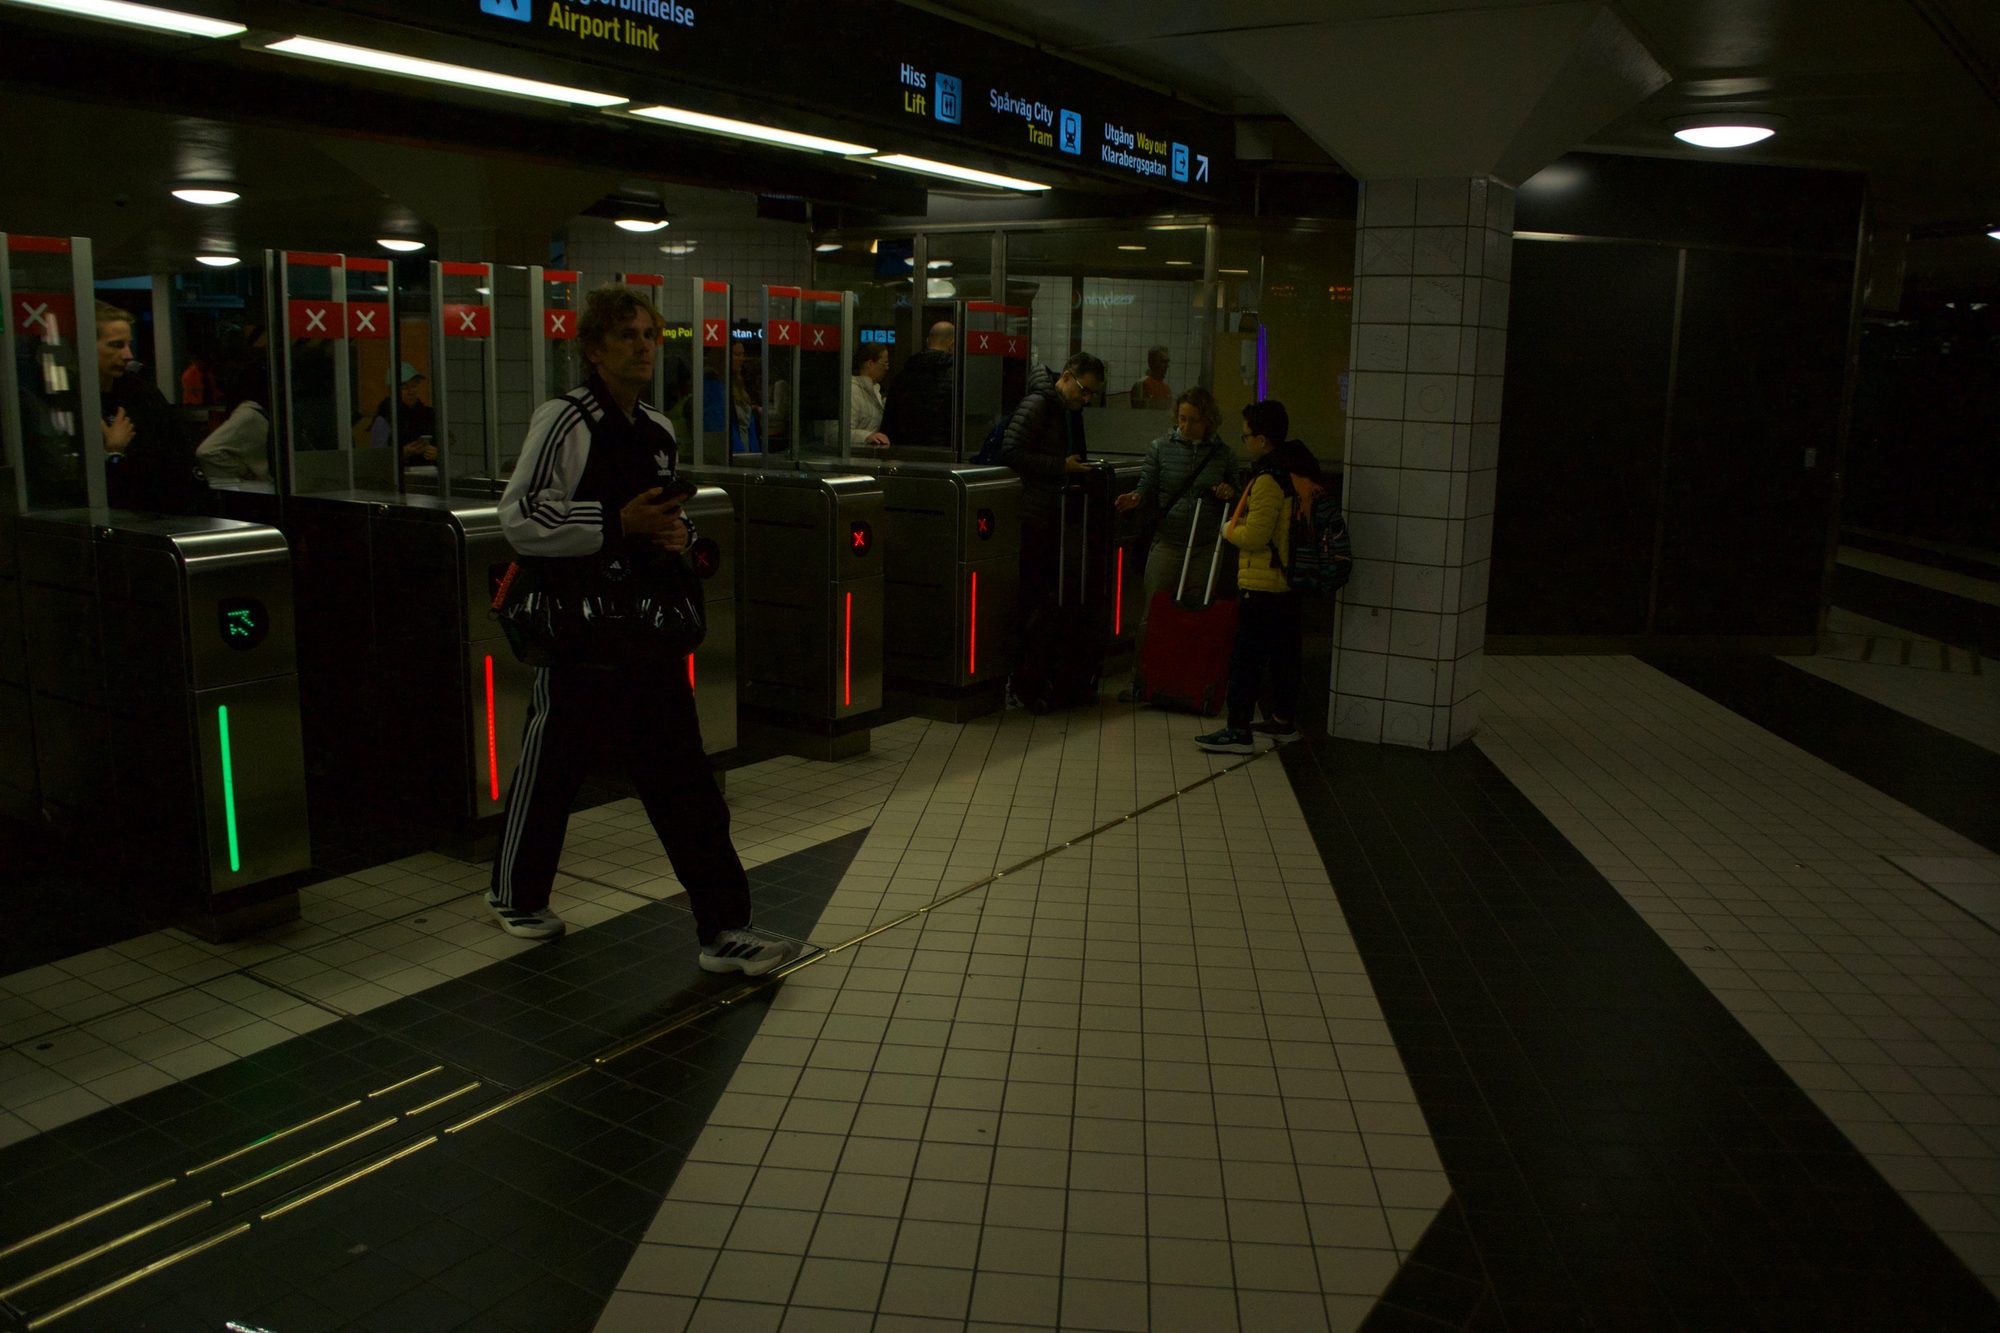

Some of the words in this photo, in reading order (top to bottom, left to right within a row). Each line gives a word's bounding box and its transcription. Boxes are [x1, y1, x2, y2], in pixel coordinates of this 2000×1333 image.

[548, 1, 621, 42] Airport
[625, 19, 660, 51] link
[900, 62, 927, 89] Hiss
[904, 91, 927, 116] Lift
[989, 87, 1033, 121] Spårväg
[1033, 101, 1054, 127] City
[1027, 123, 1054, 148] Tram
[1104, 122, 1135, 150] Utgång
[1136, 131, 1154, 155] Way
[1154, 140, 1168, 156] out
[1101, 143, 1167, 177] Klarabergsgatan
